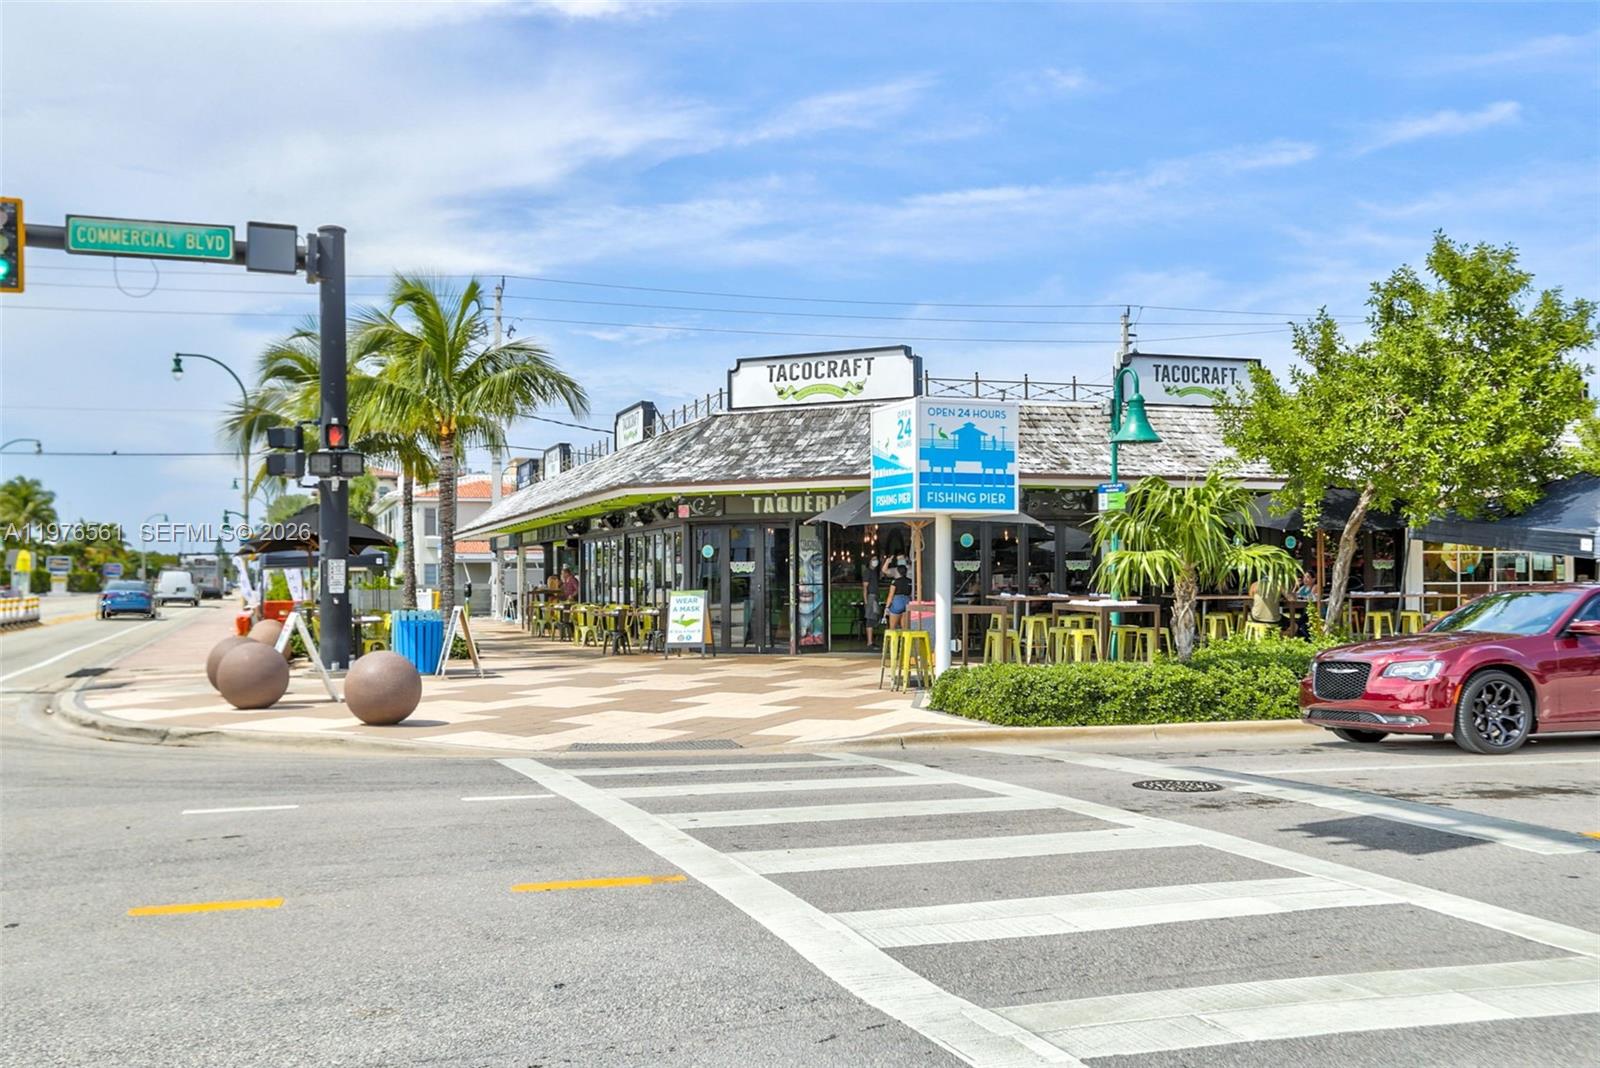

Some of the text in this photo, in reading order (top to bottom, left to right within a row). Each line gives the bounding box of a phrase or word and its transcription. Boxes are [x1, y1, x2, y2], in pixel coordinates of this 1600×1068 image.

[76, 226, 225, 251] COMMERCIAL BLVD
[766, 357, 875, 383] TACOCRAFT
[1152, 364, 1238, 385] TACOCRAFT
[927, 407, 1007, 419] OPEN 24 HOURS
[896, 417, 912, 440] 24
[898, 492, 912, 504] PIER
[927, 491, 1007, 504] FISHING PIER
